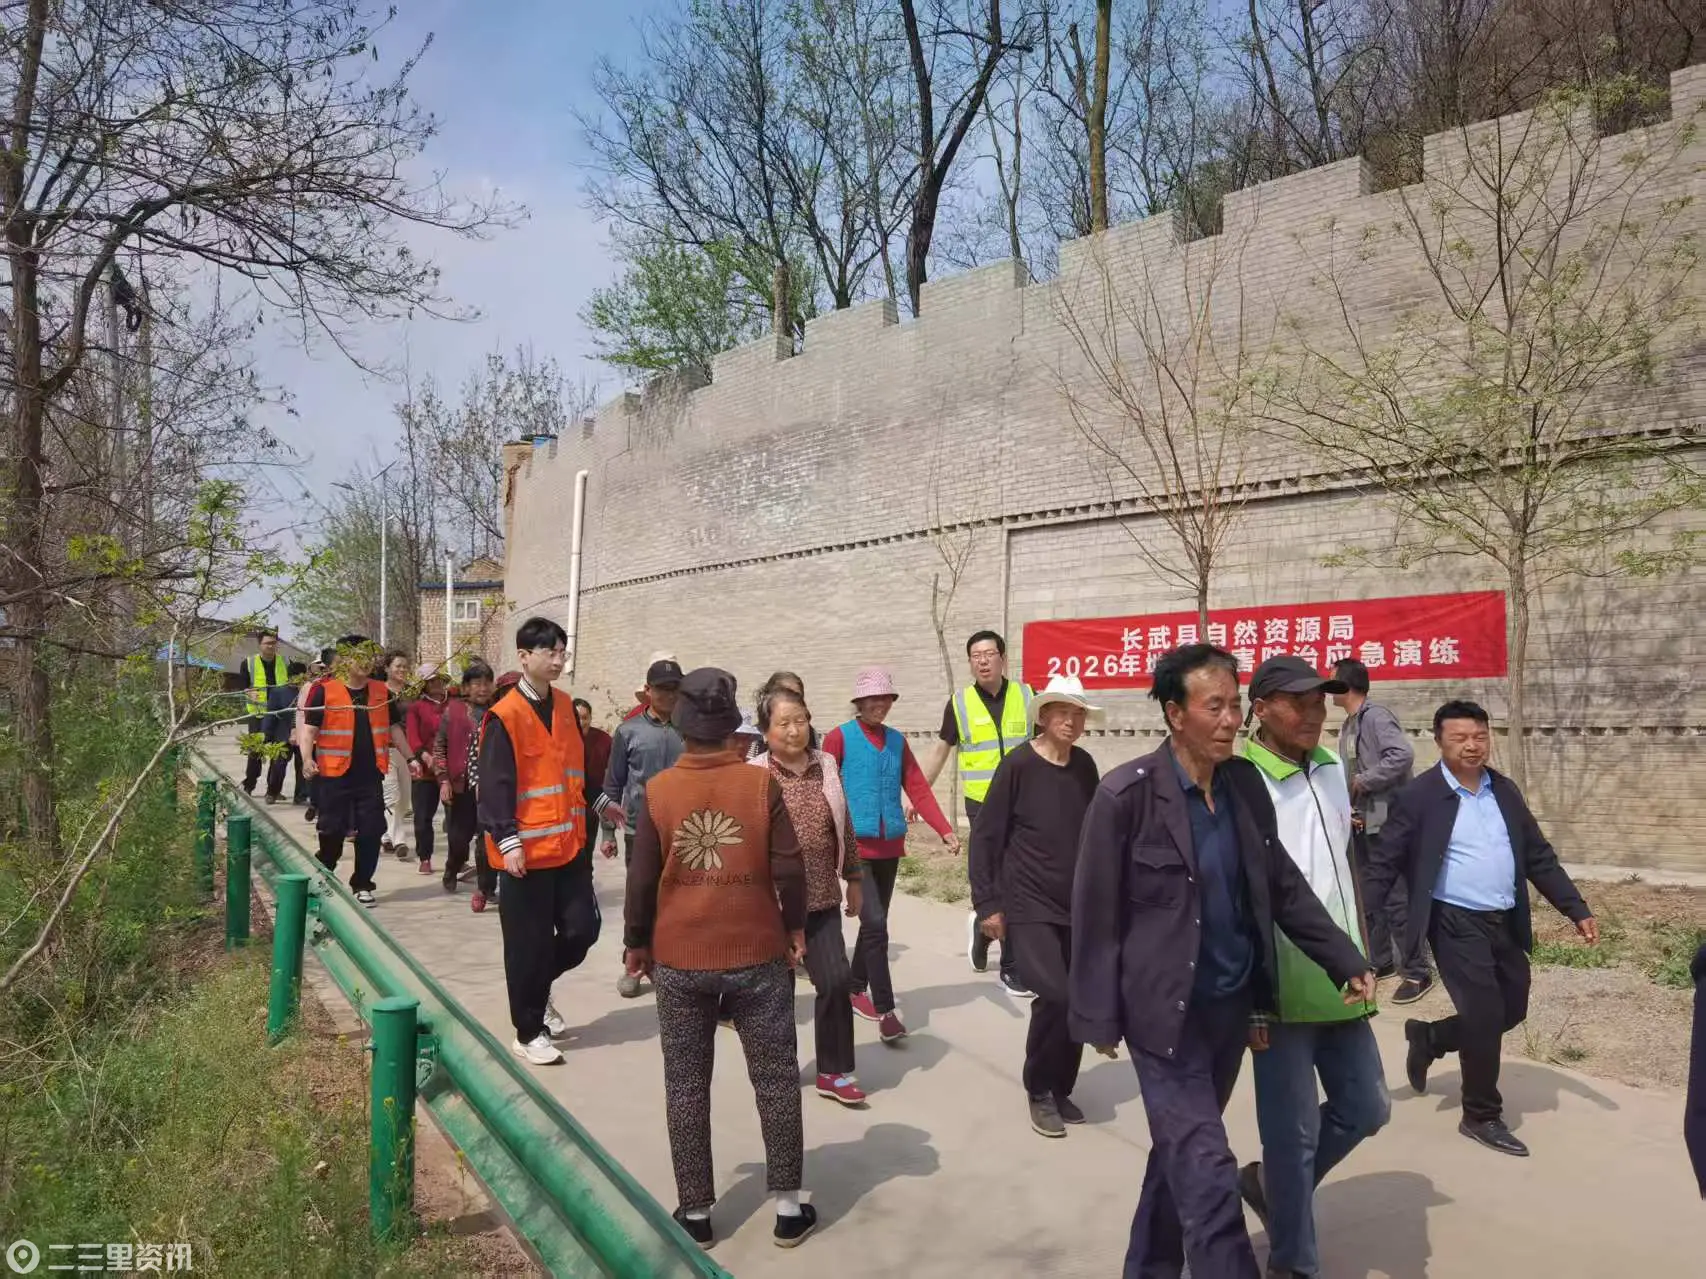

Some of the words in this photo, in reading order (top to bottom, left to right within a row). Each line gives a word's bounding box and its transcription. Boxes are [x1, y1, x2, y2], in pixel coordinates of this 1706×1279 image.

[1121, 615, 1354, 651] 长武县自然资源局
